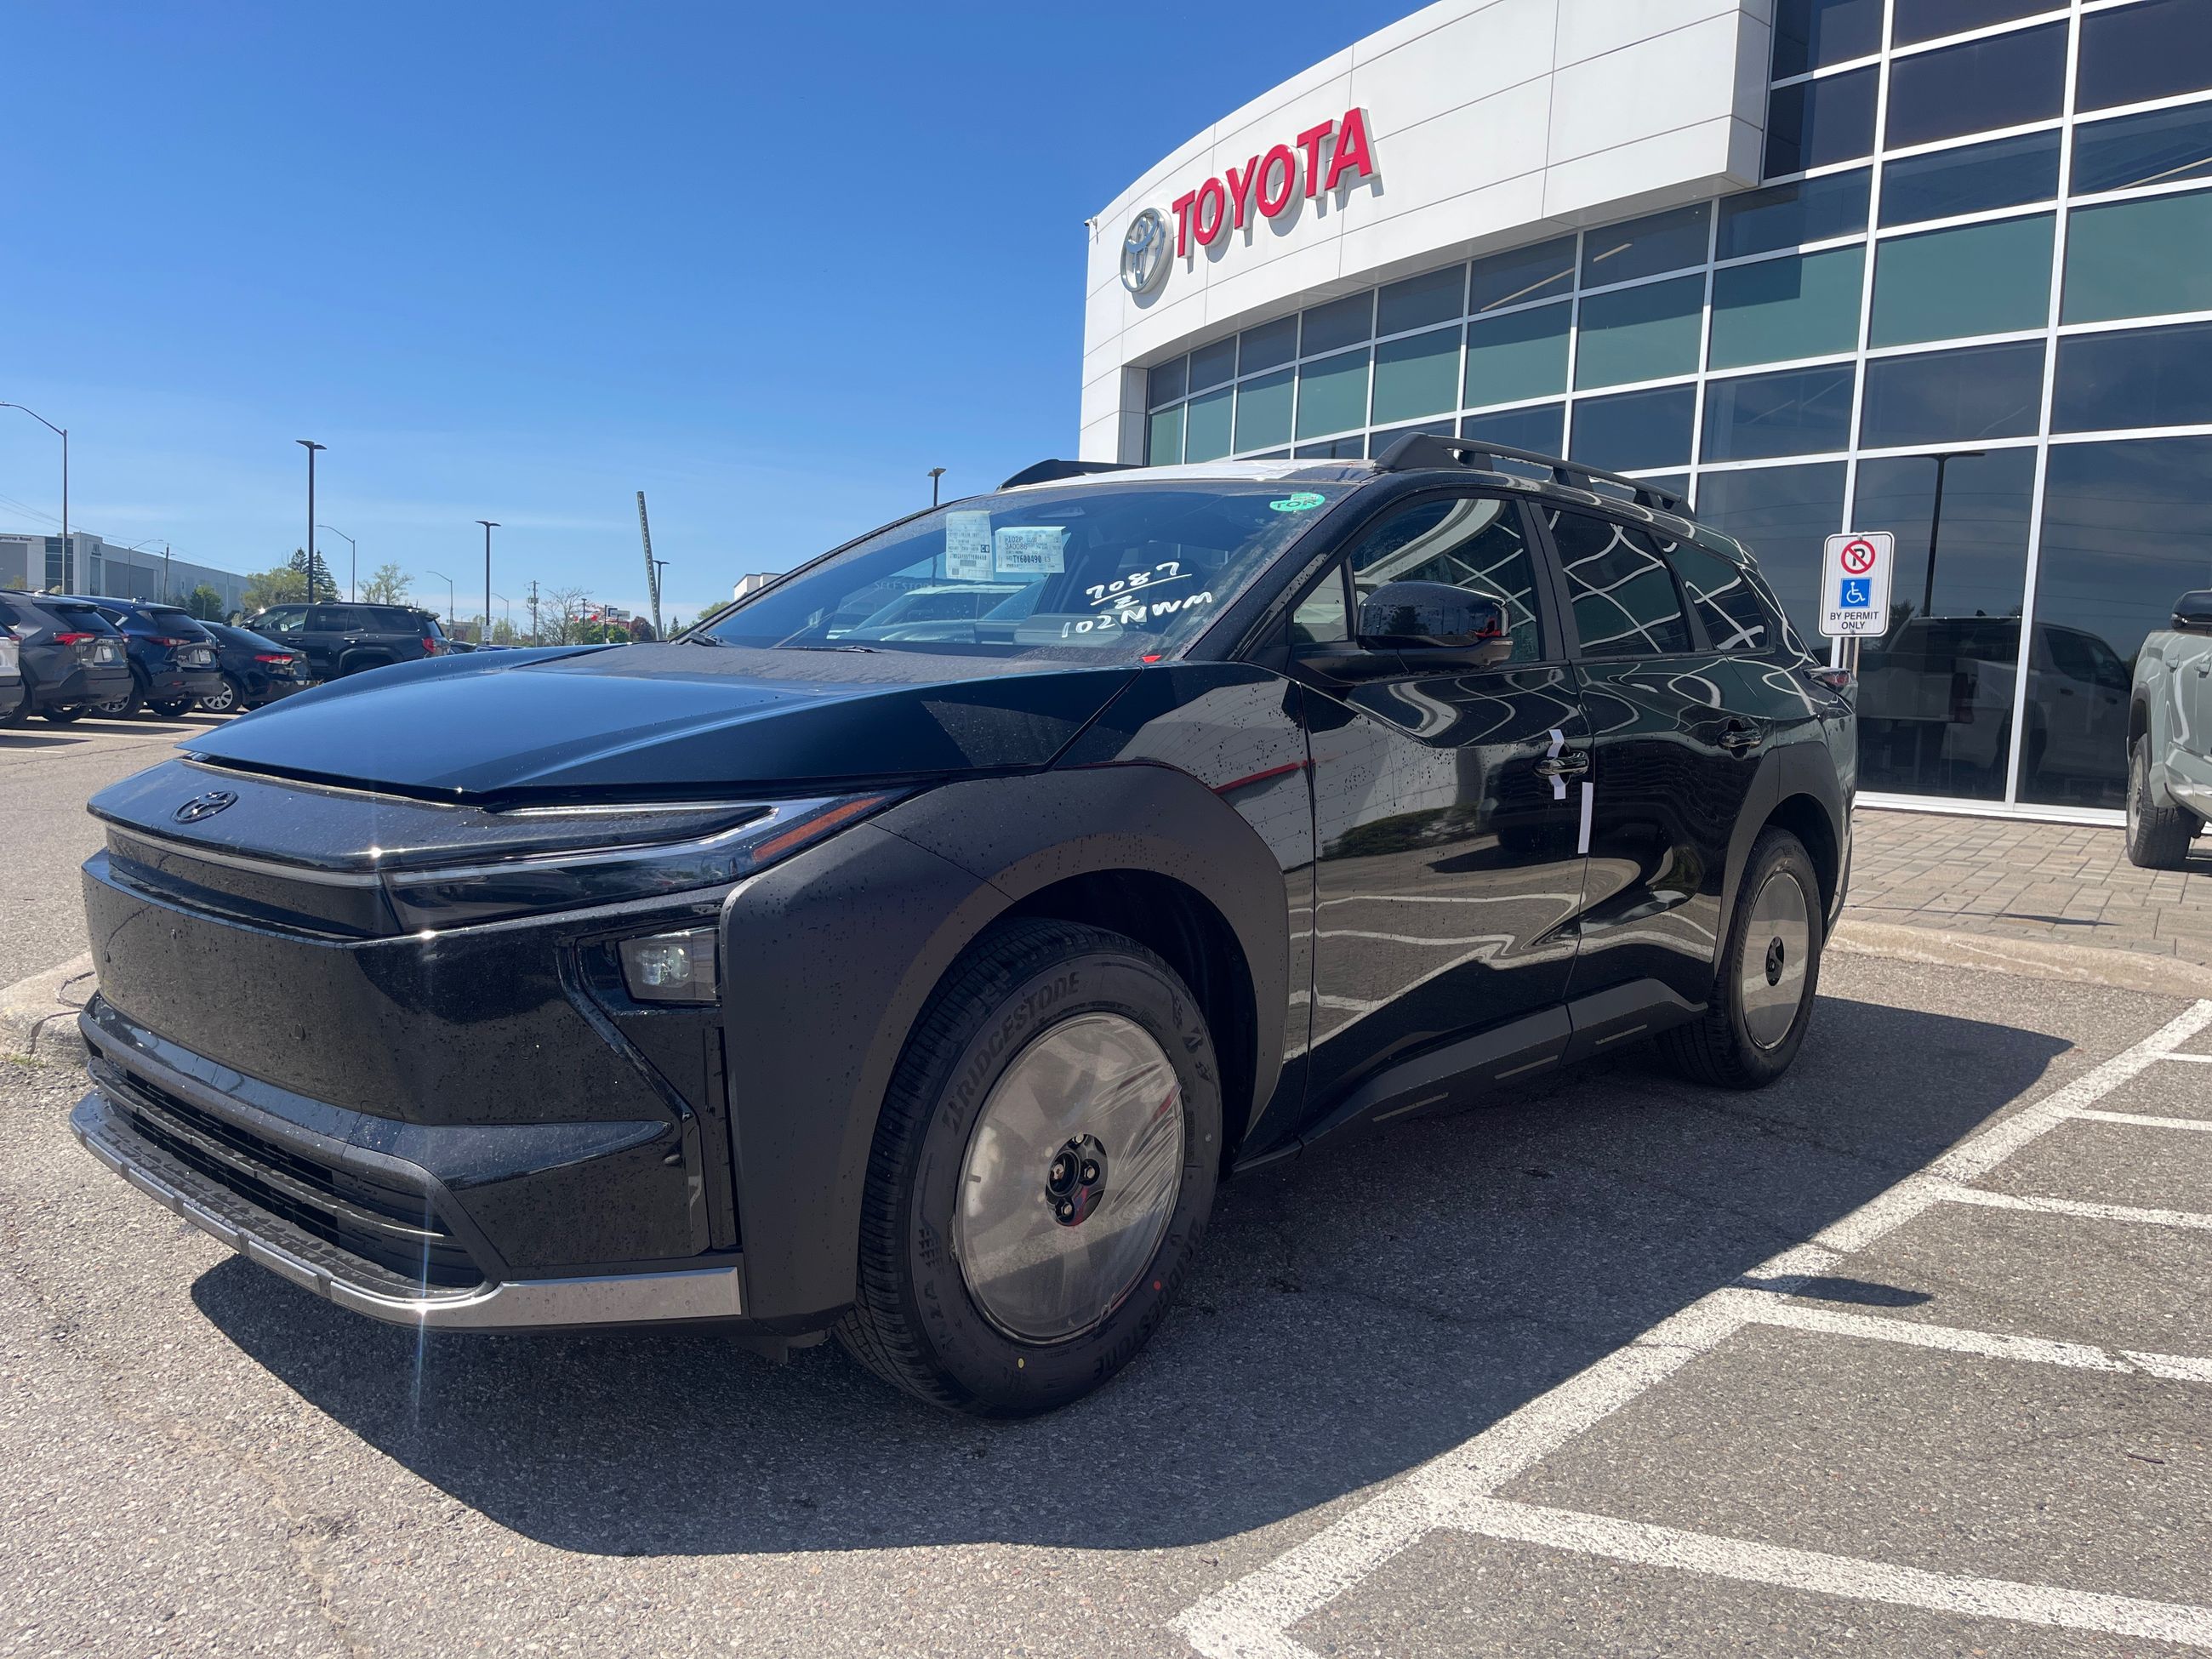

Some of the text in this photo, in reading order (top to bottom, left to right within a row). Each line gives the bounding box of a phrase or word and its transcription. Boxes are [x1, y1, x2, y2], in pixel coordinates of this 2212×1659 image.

[1172, 107, 1377, 259] TOYOTA
[1086, 562, 1180, 599] 7087
[1830, 611, 1879, 620] BY PERMIT
[941, 971, 1080, 1137] BRIDGESTONE
